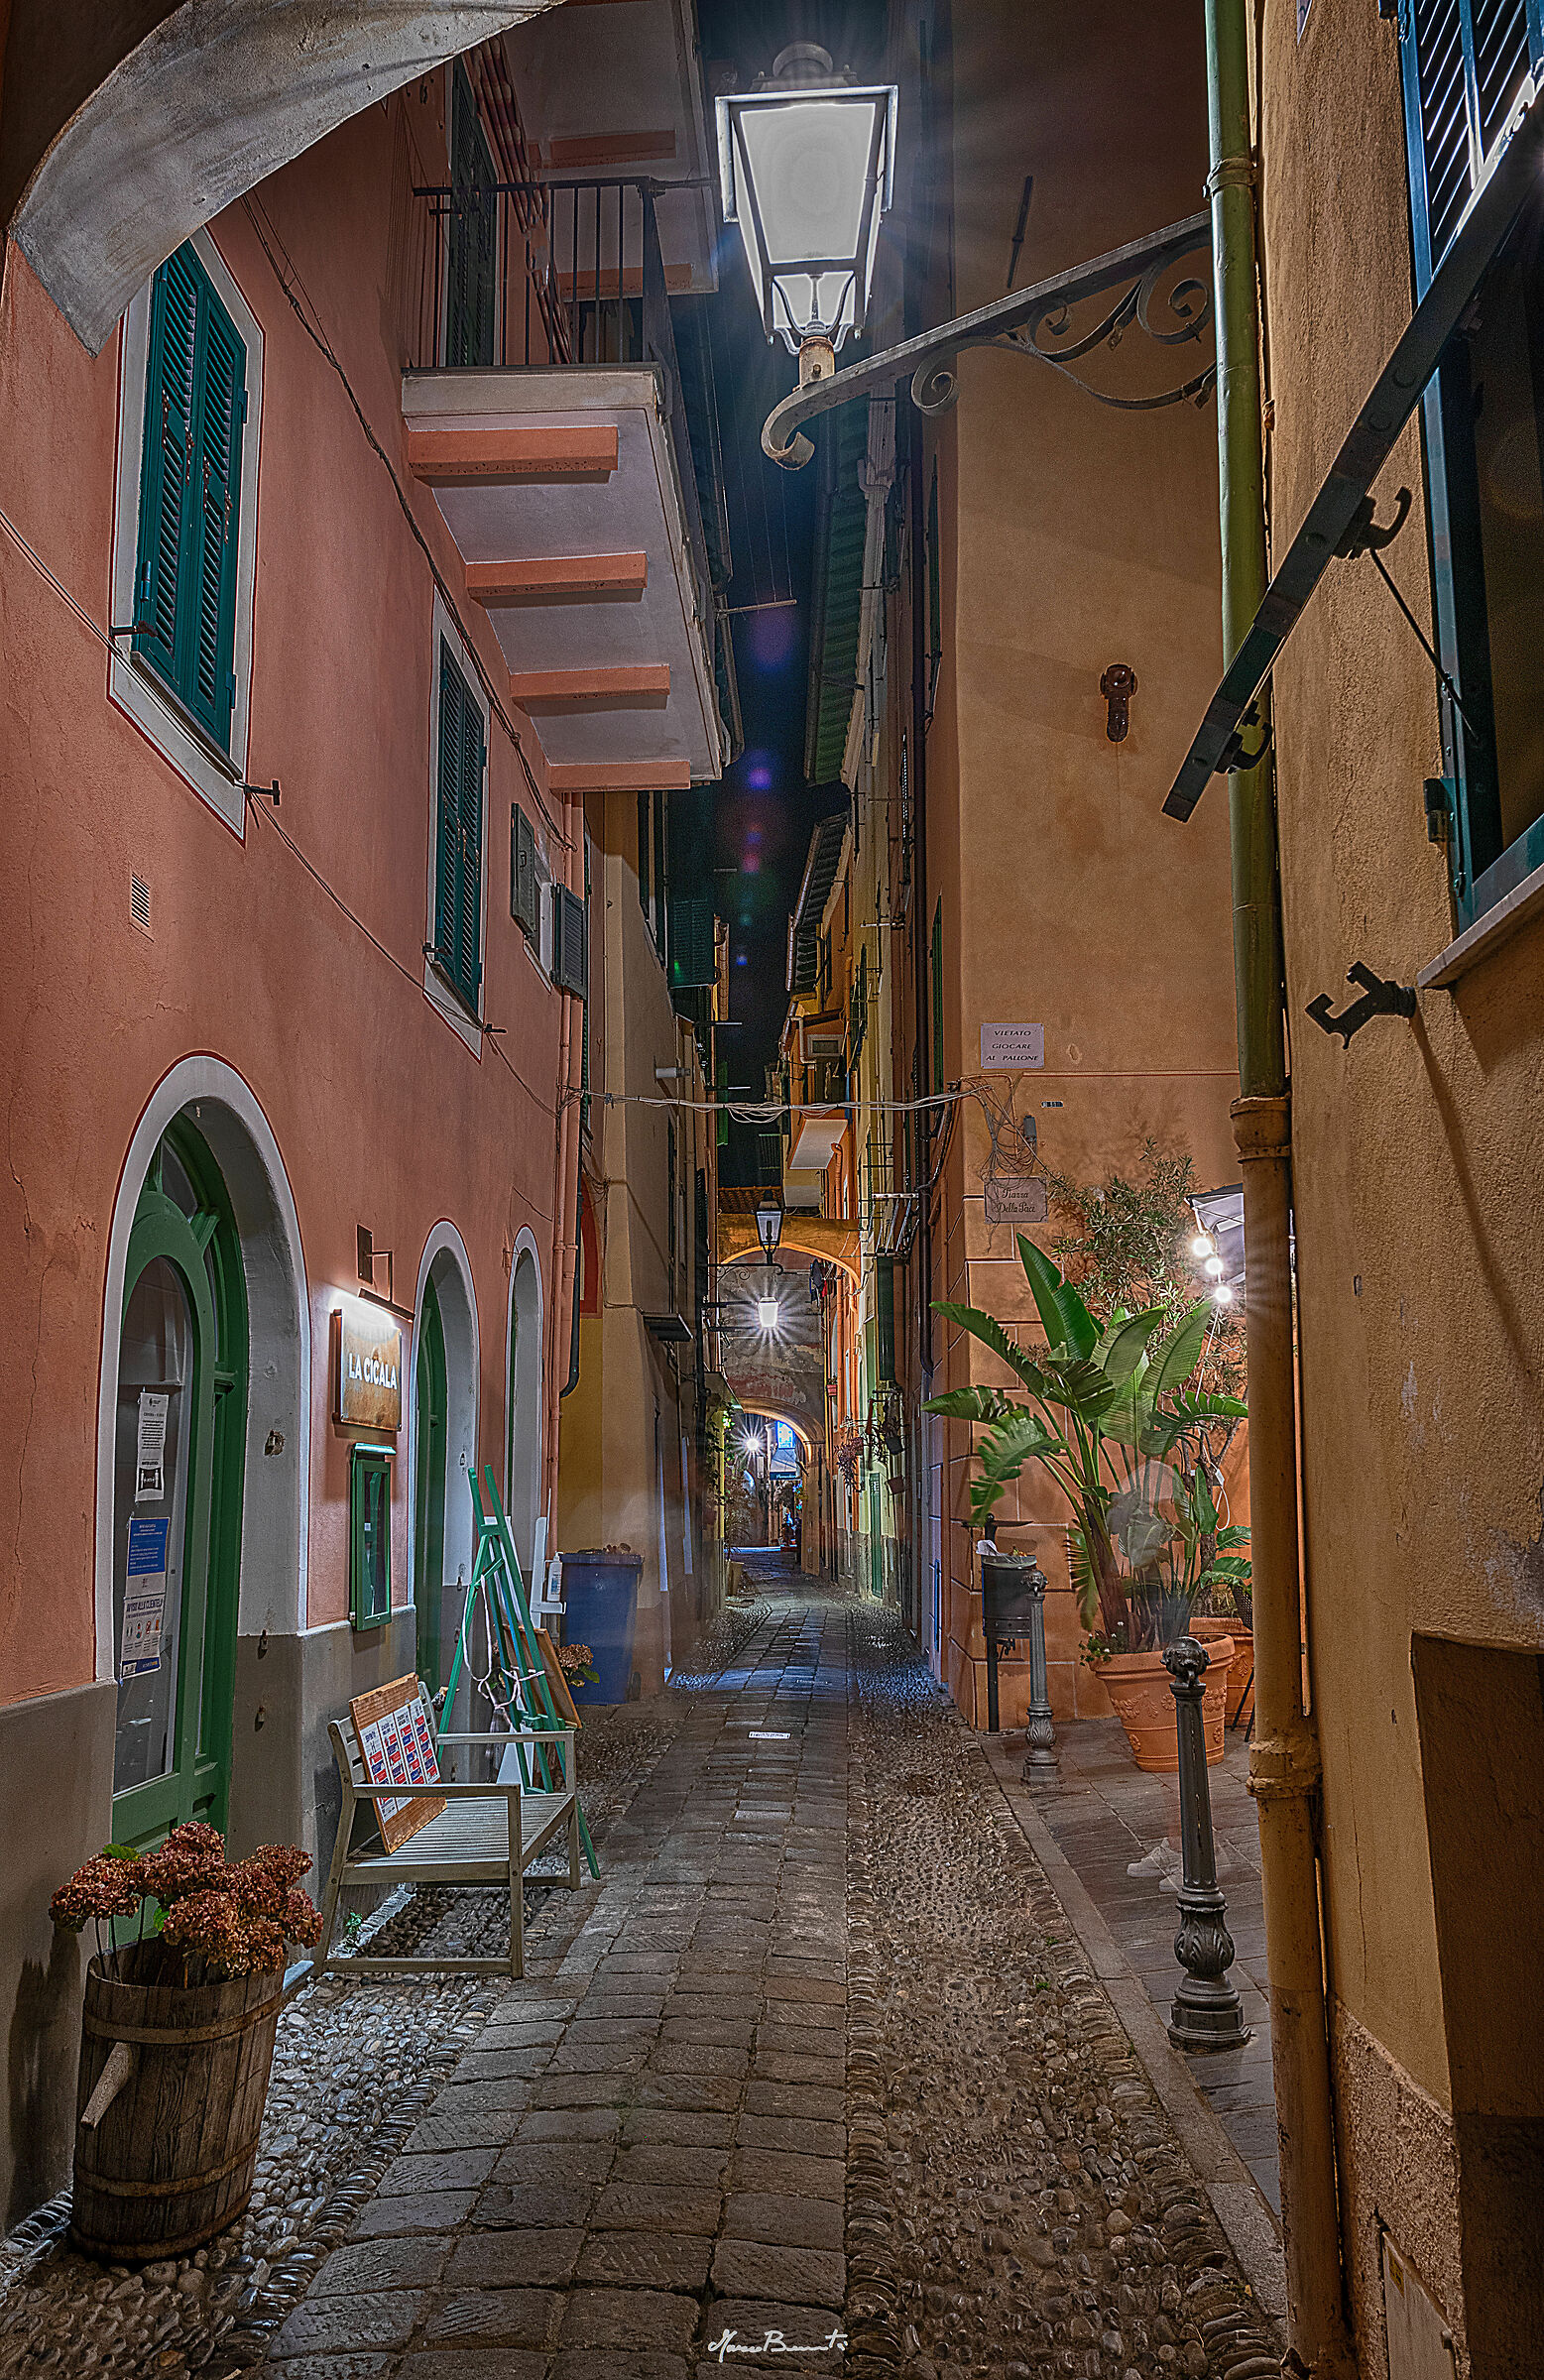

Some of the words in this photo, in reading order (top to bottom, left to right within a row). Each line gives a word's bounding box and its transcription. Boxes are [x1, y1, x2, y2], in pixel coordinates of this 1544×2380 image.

[1002, 1188, 1029, 1199] Piazza
[997, 1202, 1018, 1214] Della
[1018, 1201, 1036, 1213] Pace
[348, 1353, 363, 1380] LA
[363, 1357, 398, 1390] CICALA
